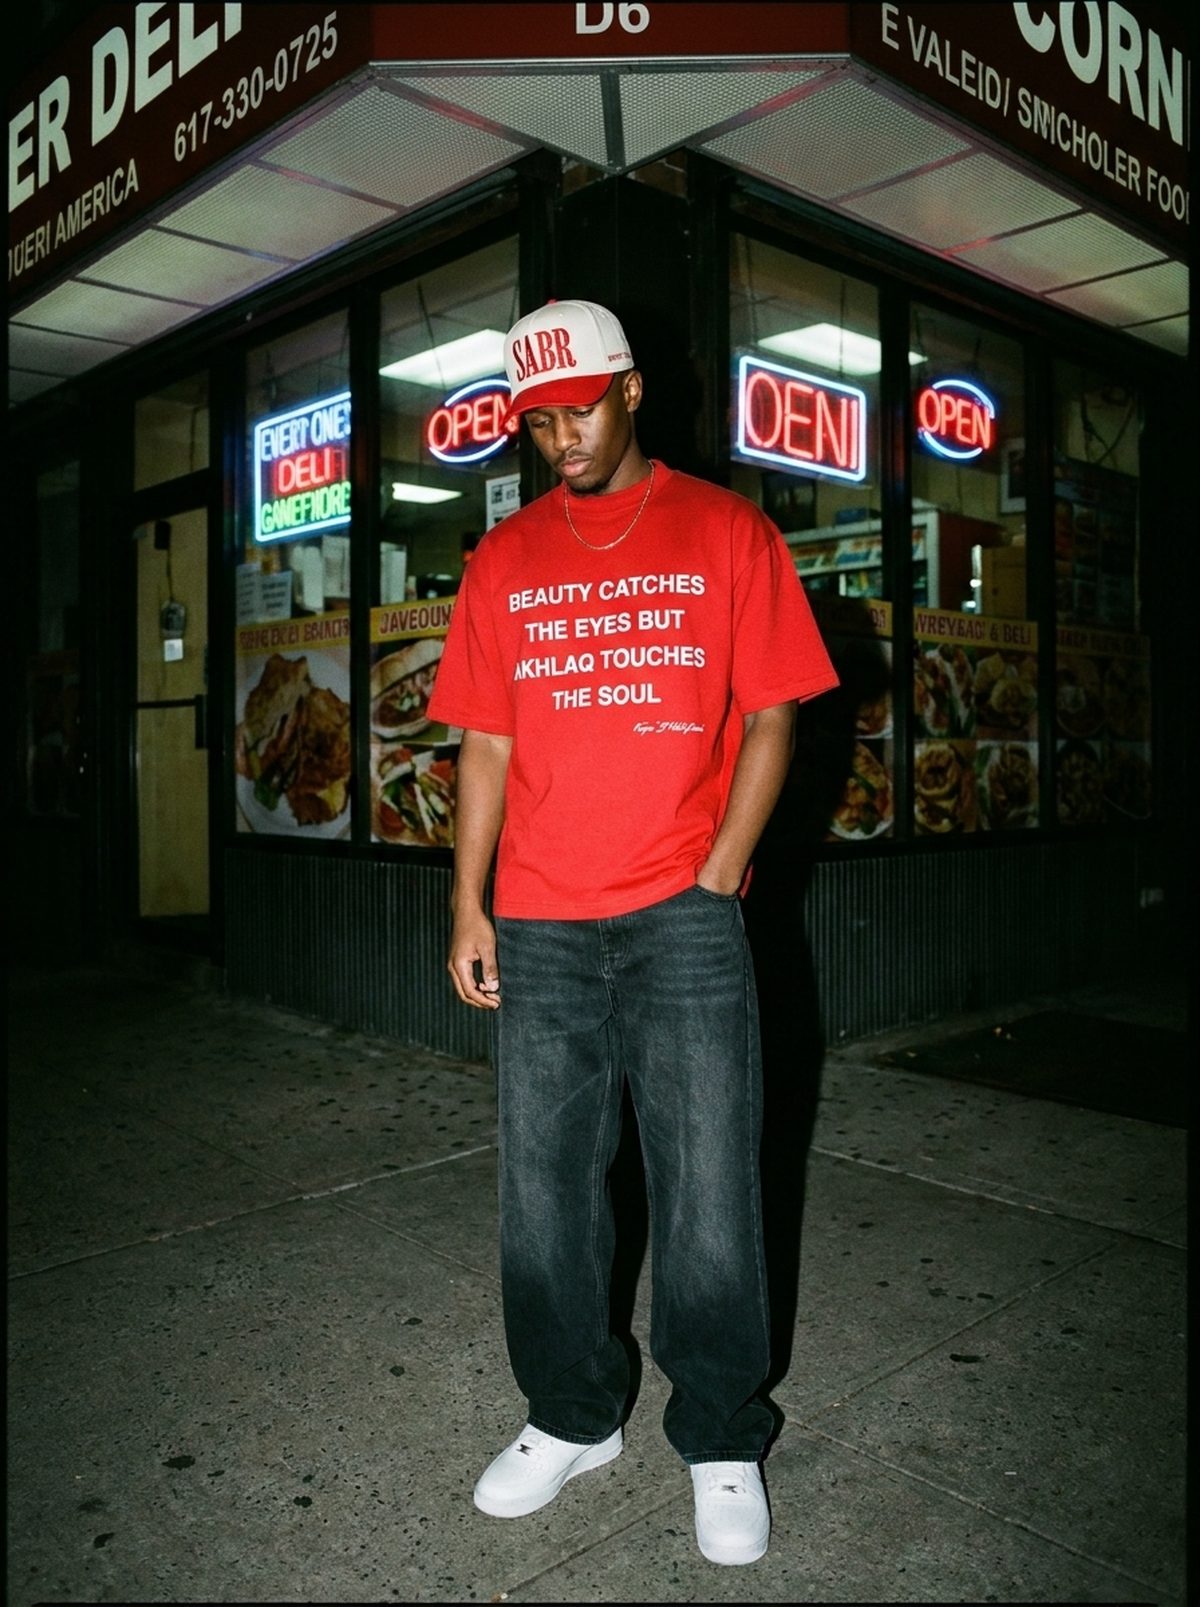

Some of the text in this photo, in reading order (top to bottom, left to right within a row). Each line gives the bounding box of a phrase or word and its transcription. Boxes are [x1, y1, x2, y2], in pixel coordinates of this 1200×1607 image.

[174, 11, 338, 163] 617-330-0725
[1012, 2, 1191, 152] CORN
[8, 75, 72, 214] ER
[55, 158, 139, 249] AMERICA
[1147, 166, 1190, 225] FOO
[512, 327, 577, 382] SABR
[919, 389, 991, 449] OPEN
[278, 446, 331, 493] DELI
[509, 574, 705, 613] BEAUTY CATCHES
[525, 609, 685, 643] THE EYES BUT
[514, 646, 705, 681] AKHLAQ TOUCHES
[552, 683, 662, 710] THE SOUL
